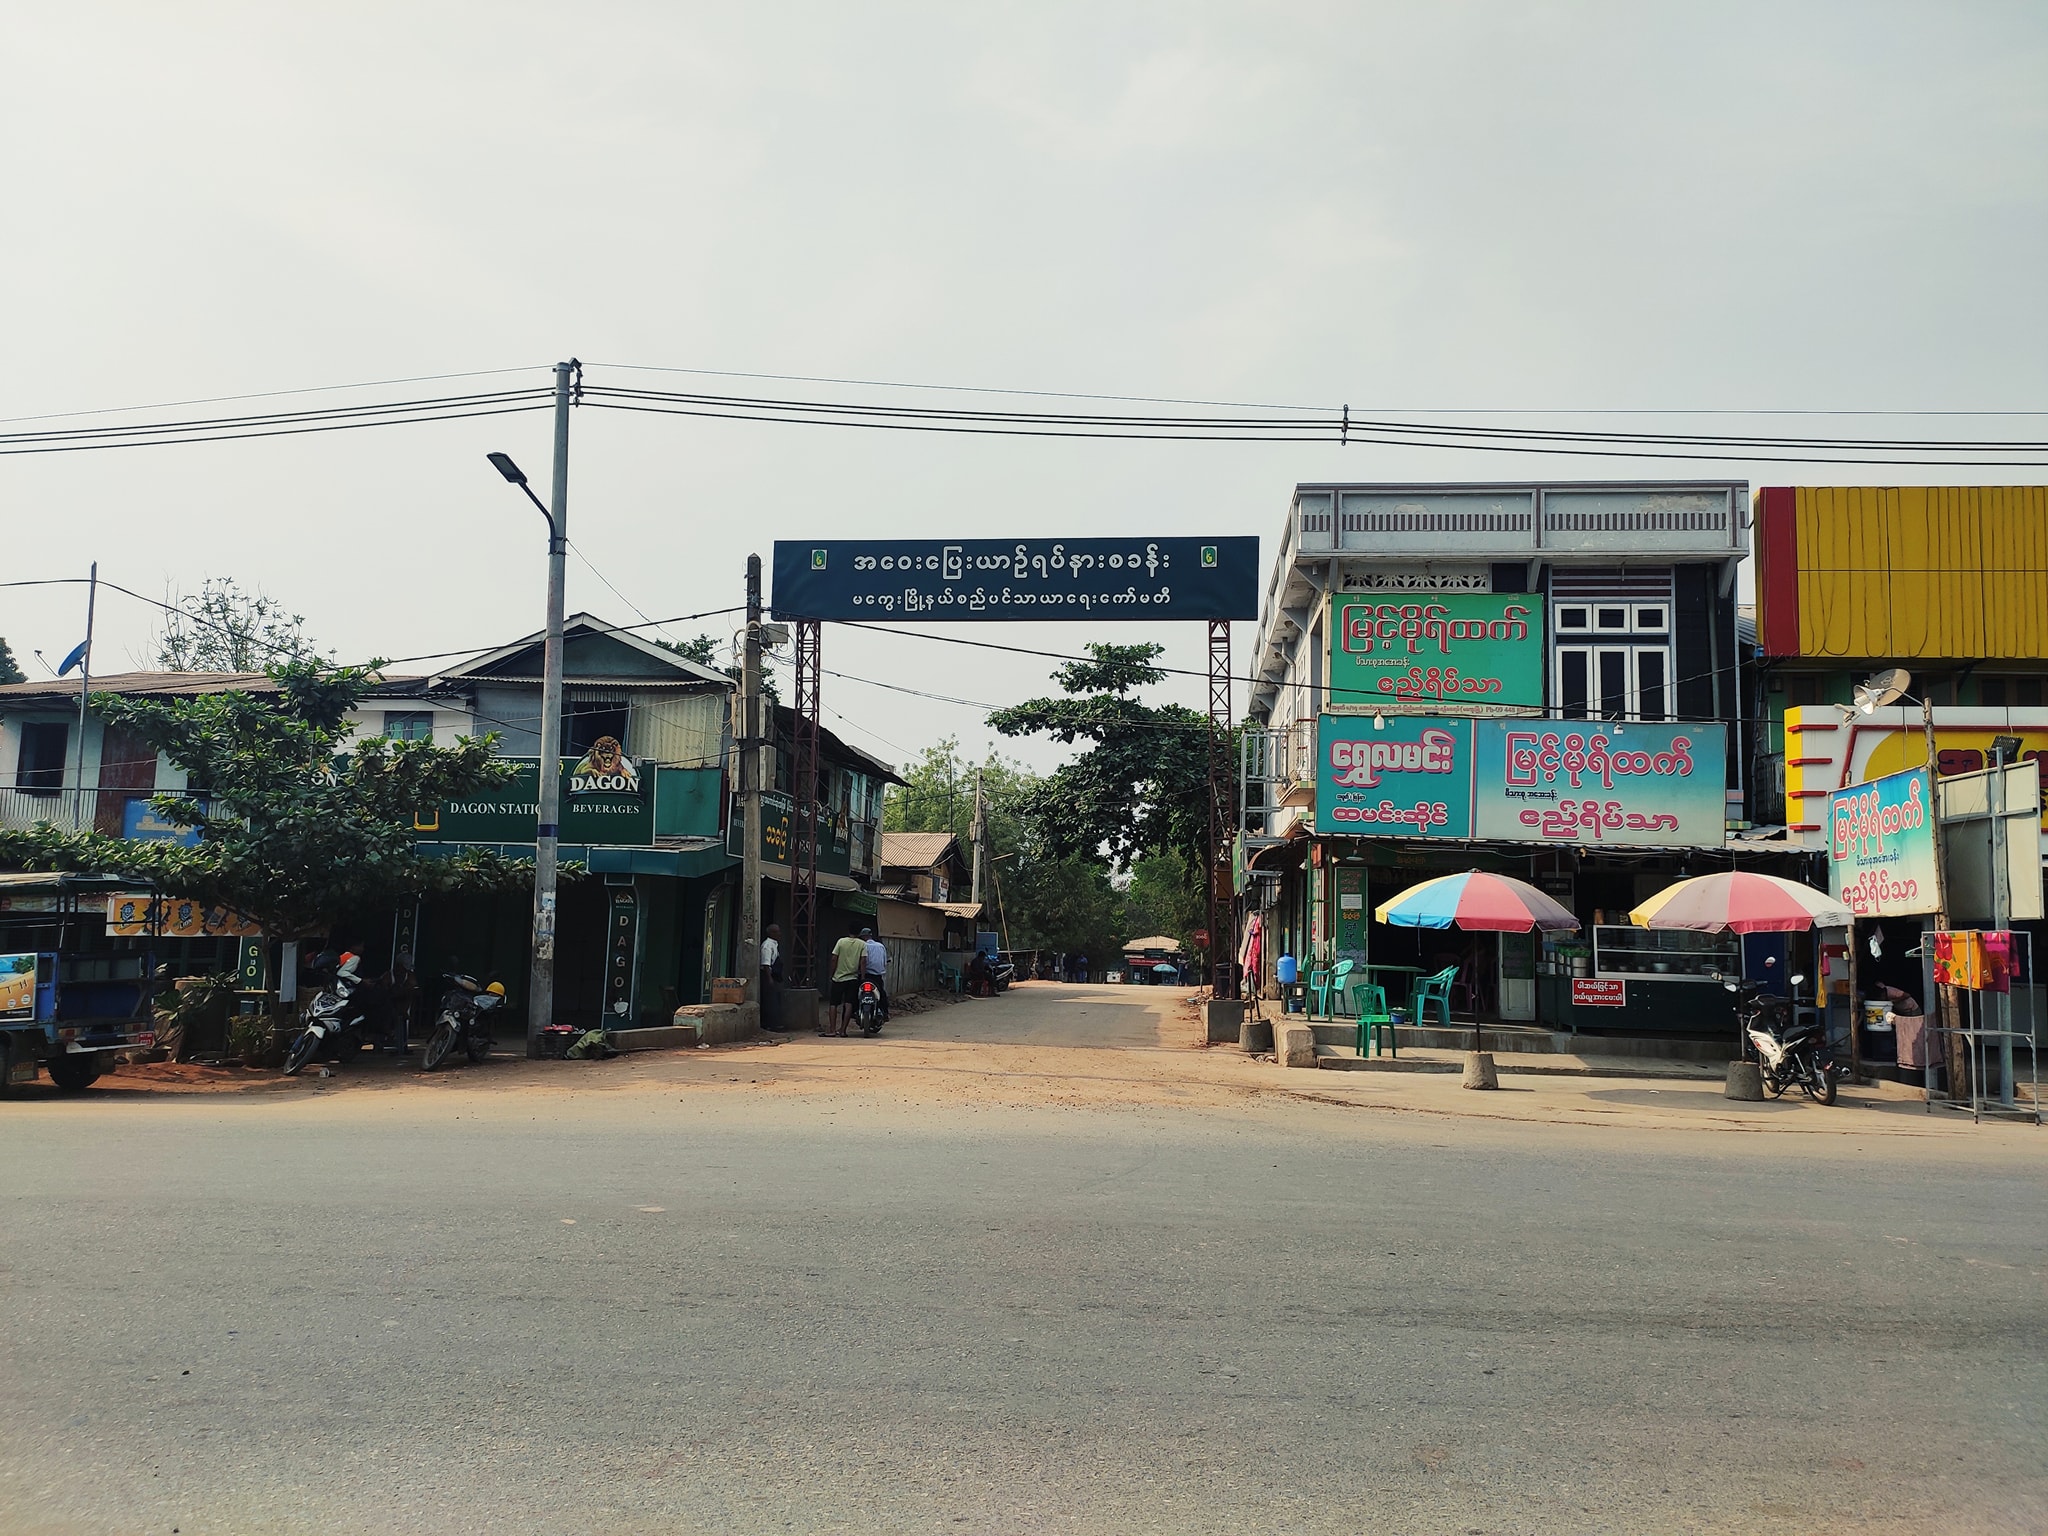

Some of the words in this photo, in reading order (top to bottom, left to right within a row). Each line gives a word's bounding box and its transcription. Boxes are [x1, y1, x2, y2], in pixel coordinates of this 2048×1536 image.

[569, 774, 640, 793] DAGON
[450, 802, 496, 814] DAGON
[499, 803, 541, 814] STATI
[572, 804, 640, 814] BEVERAGES
[613, 914, 630, 1001] DAGO
